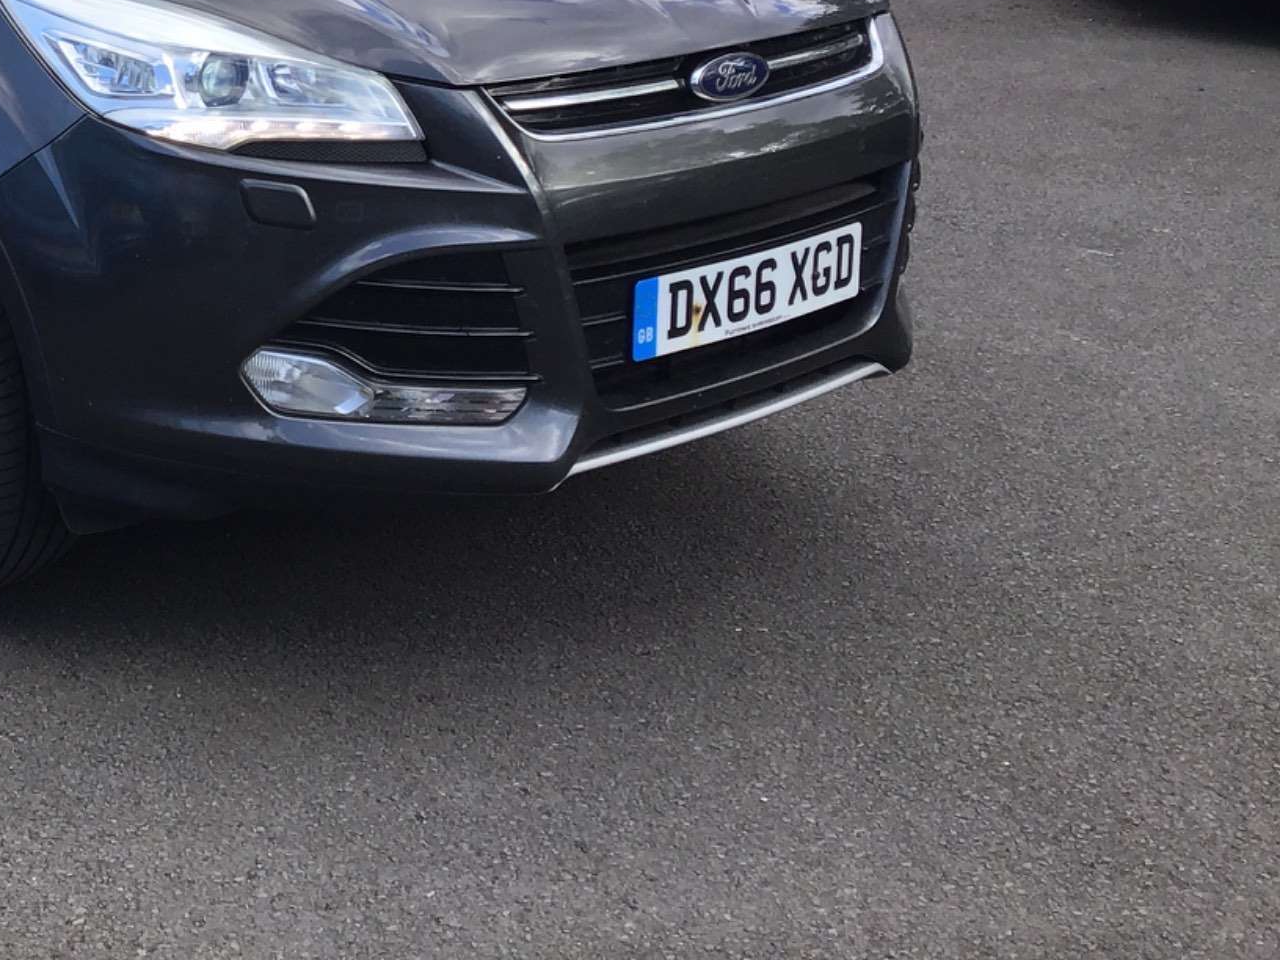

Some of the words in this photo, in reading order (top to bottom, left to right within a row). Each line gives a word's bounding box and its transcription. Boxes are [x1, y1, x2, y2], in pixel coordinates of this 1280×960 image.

[715, 60, 757, 92] Ford
[667, 257, 778, 340] DX66
[788, 233, 854, 306] XGD
[637, 326, 654, 344] GB
